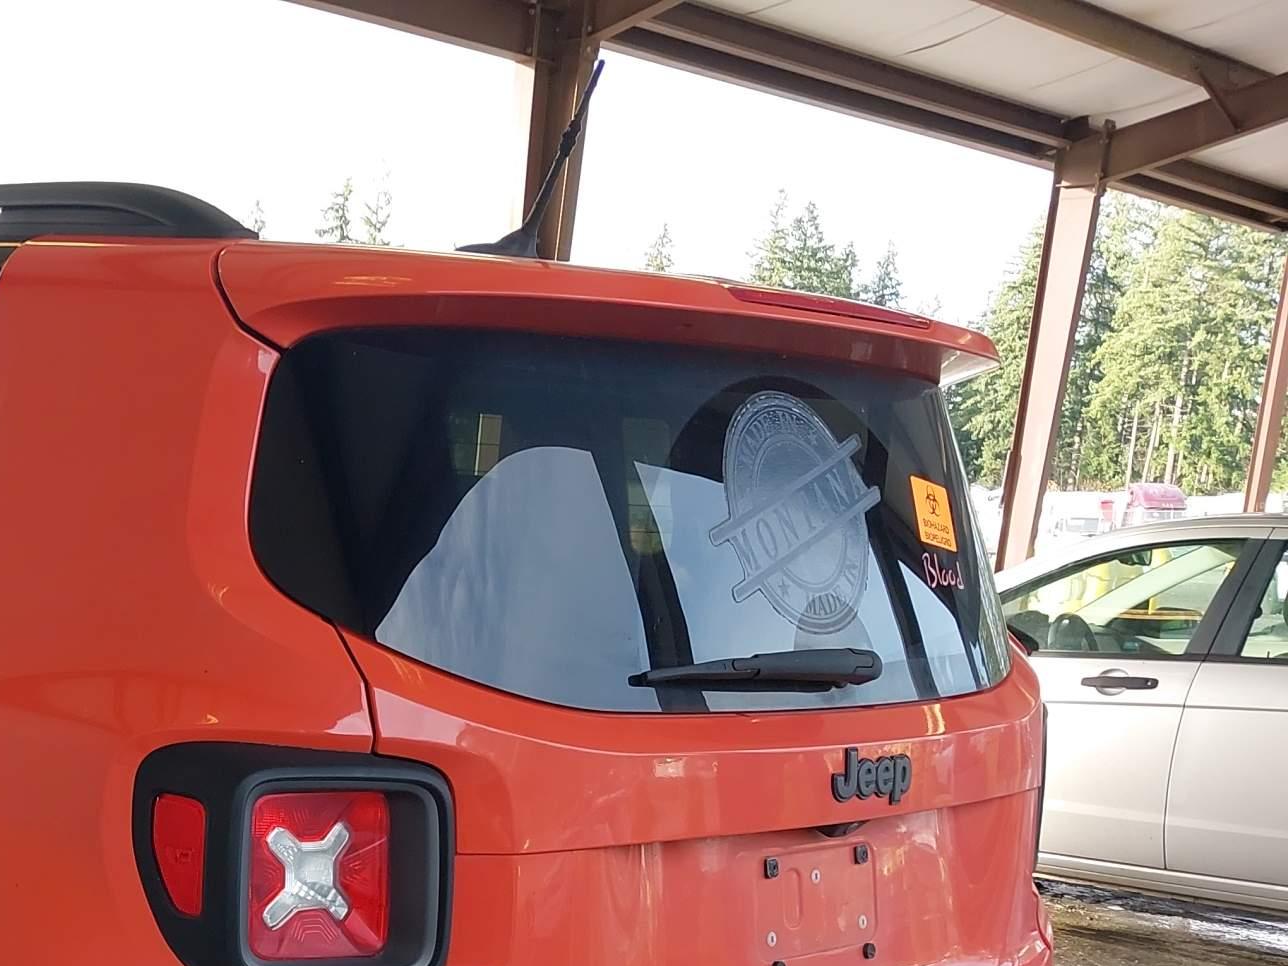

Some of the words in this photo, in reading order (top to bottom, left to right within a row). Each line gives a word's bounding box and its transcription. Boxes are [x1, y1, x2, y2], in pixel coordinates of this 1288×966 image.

[731, 466, 867, 574] MONTANA
[922, 552, 964, 590] Blood
[806, 591, 847, 616] MADE
[831, 747, 911, 806] Jeep
